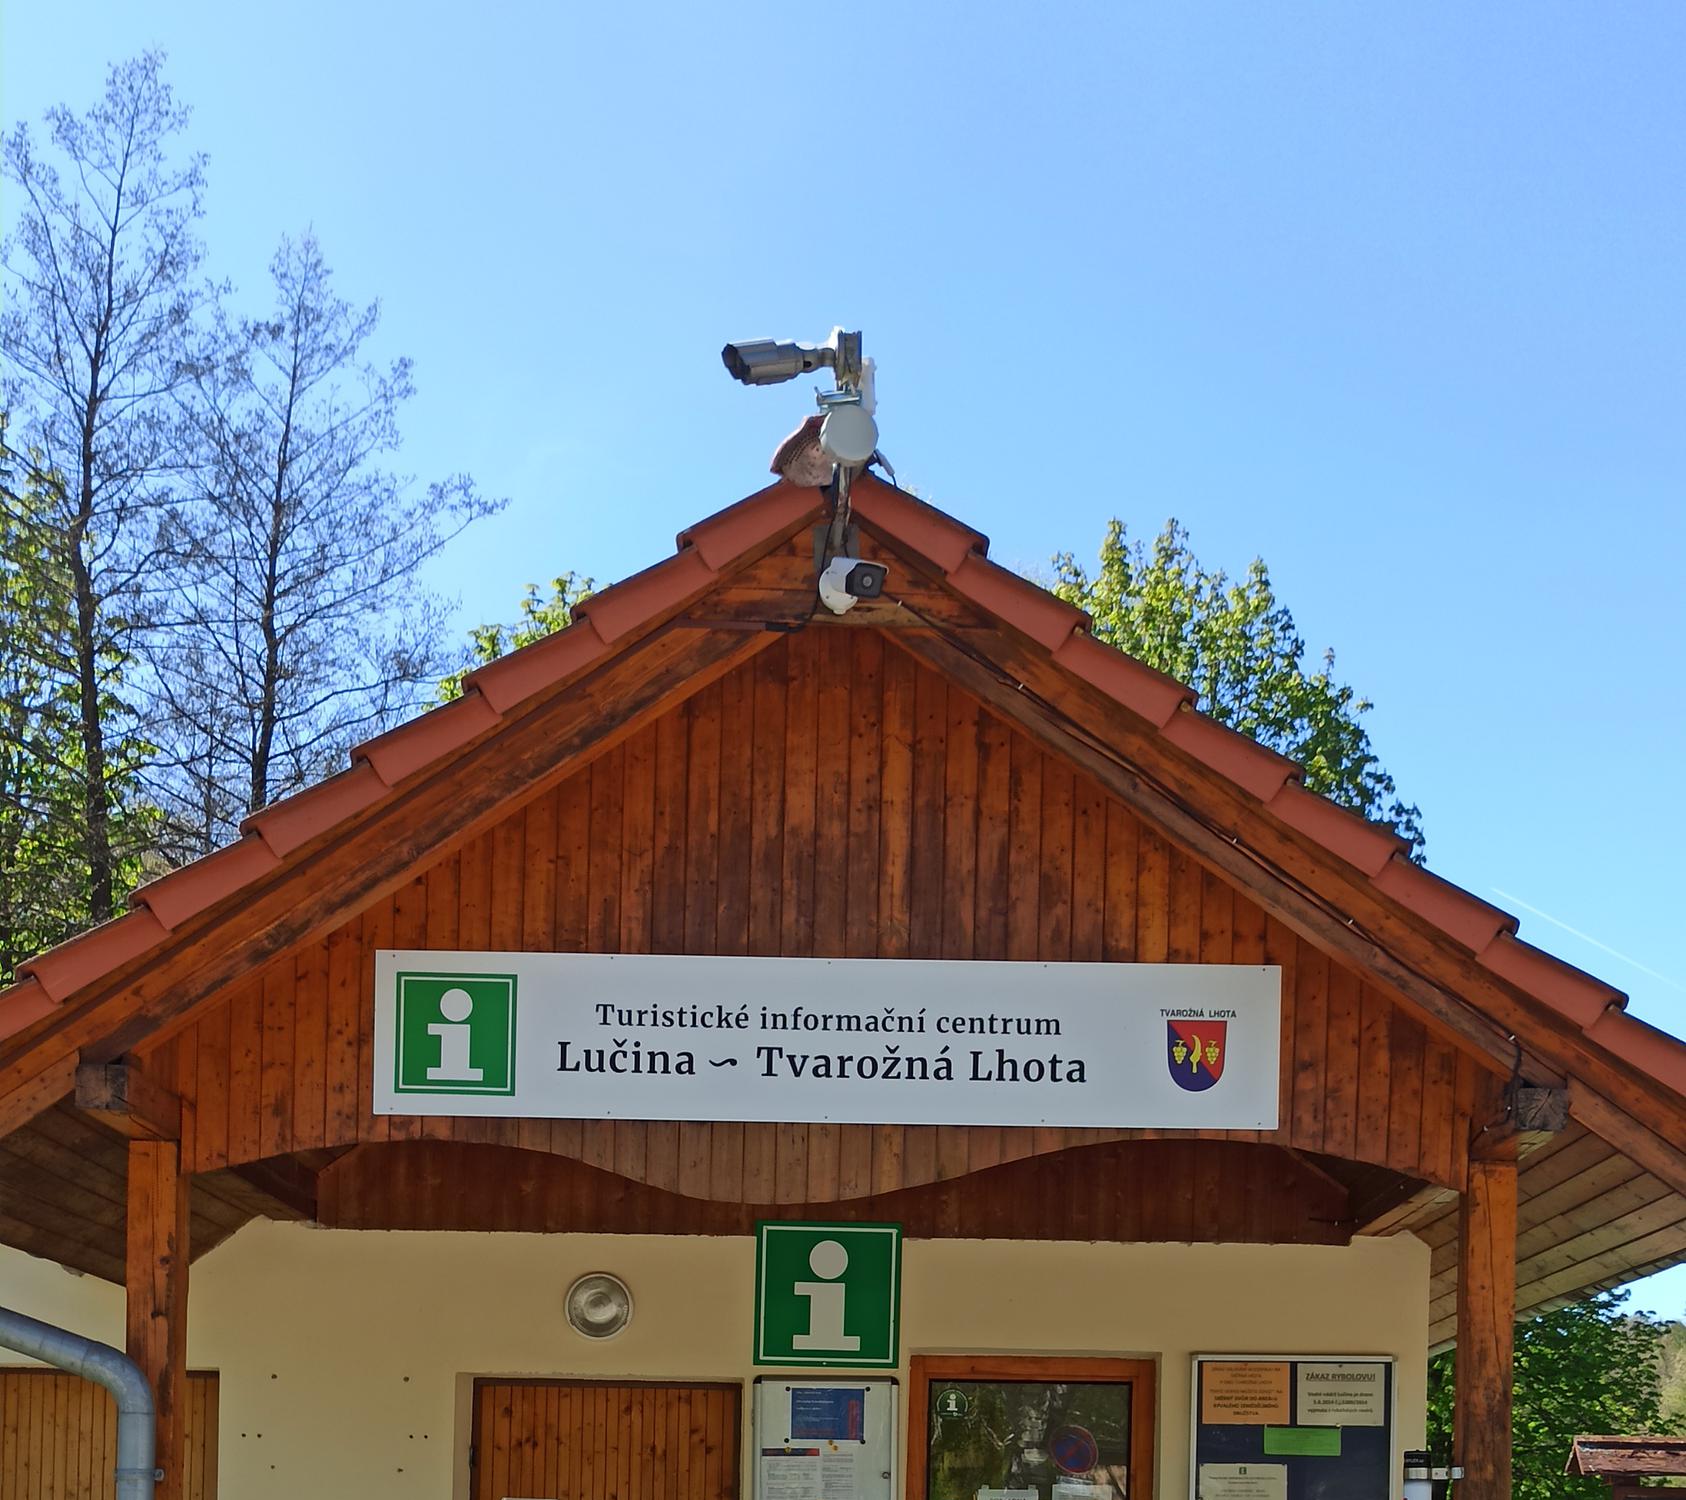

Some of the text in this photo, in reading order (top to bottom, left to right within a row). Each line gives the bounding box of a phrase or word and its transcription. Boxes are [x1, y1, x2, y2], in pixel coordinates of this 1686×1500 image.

[595, 1003, 1062, 1036] Turistické informační centrum
[1160, 1008, 1237, 1018] TVAROŽNÁ LHOTA
[556, 1038, 696, 1075] Lučina
[756, 1045, 954, 1081] Tvarožná
[969, 1049, 1086, 1083] Lhota
[1305, 1372, 1330, 1380] ZÁKAZ
